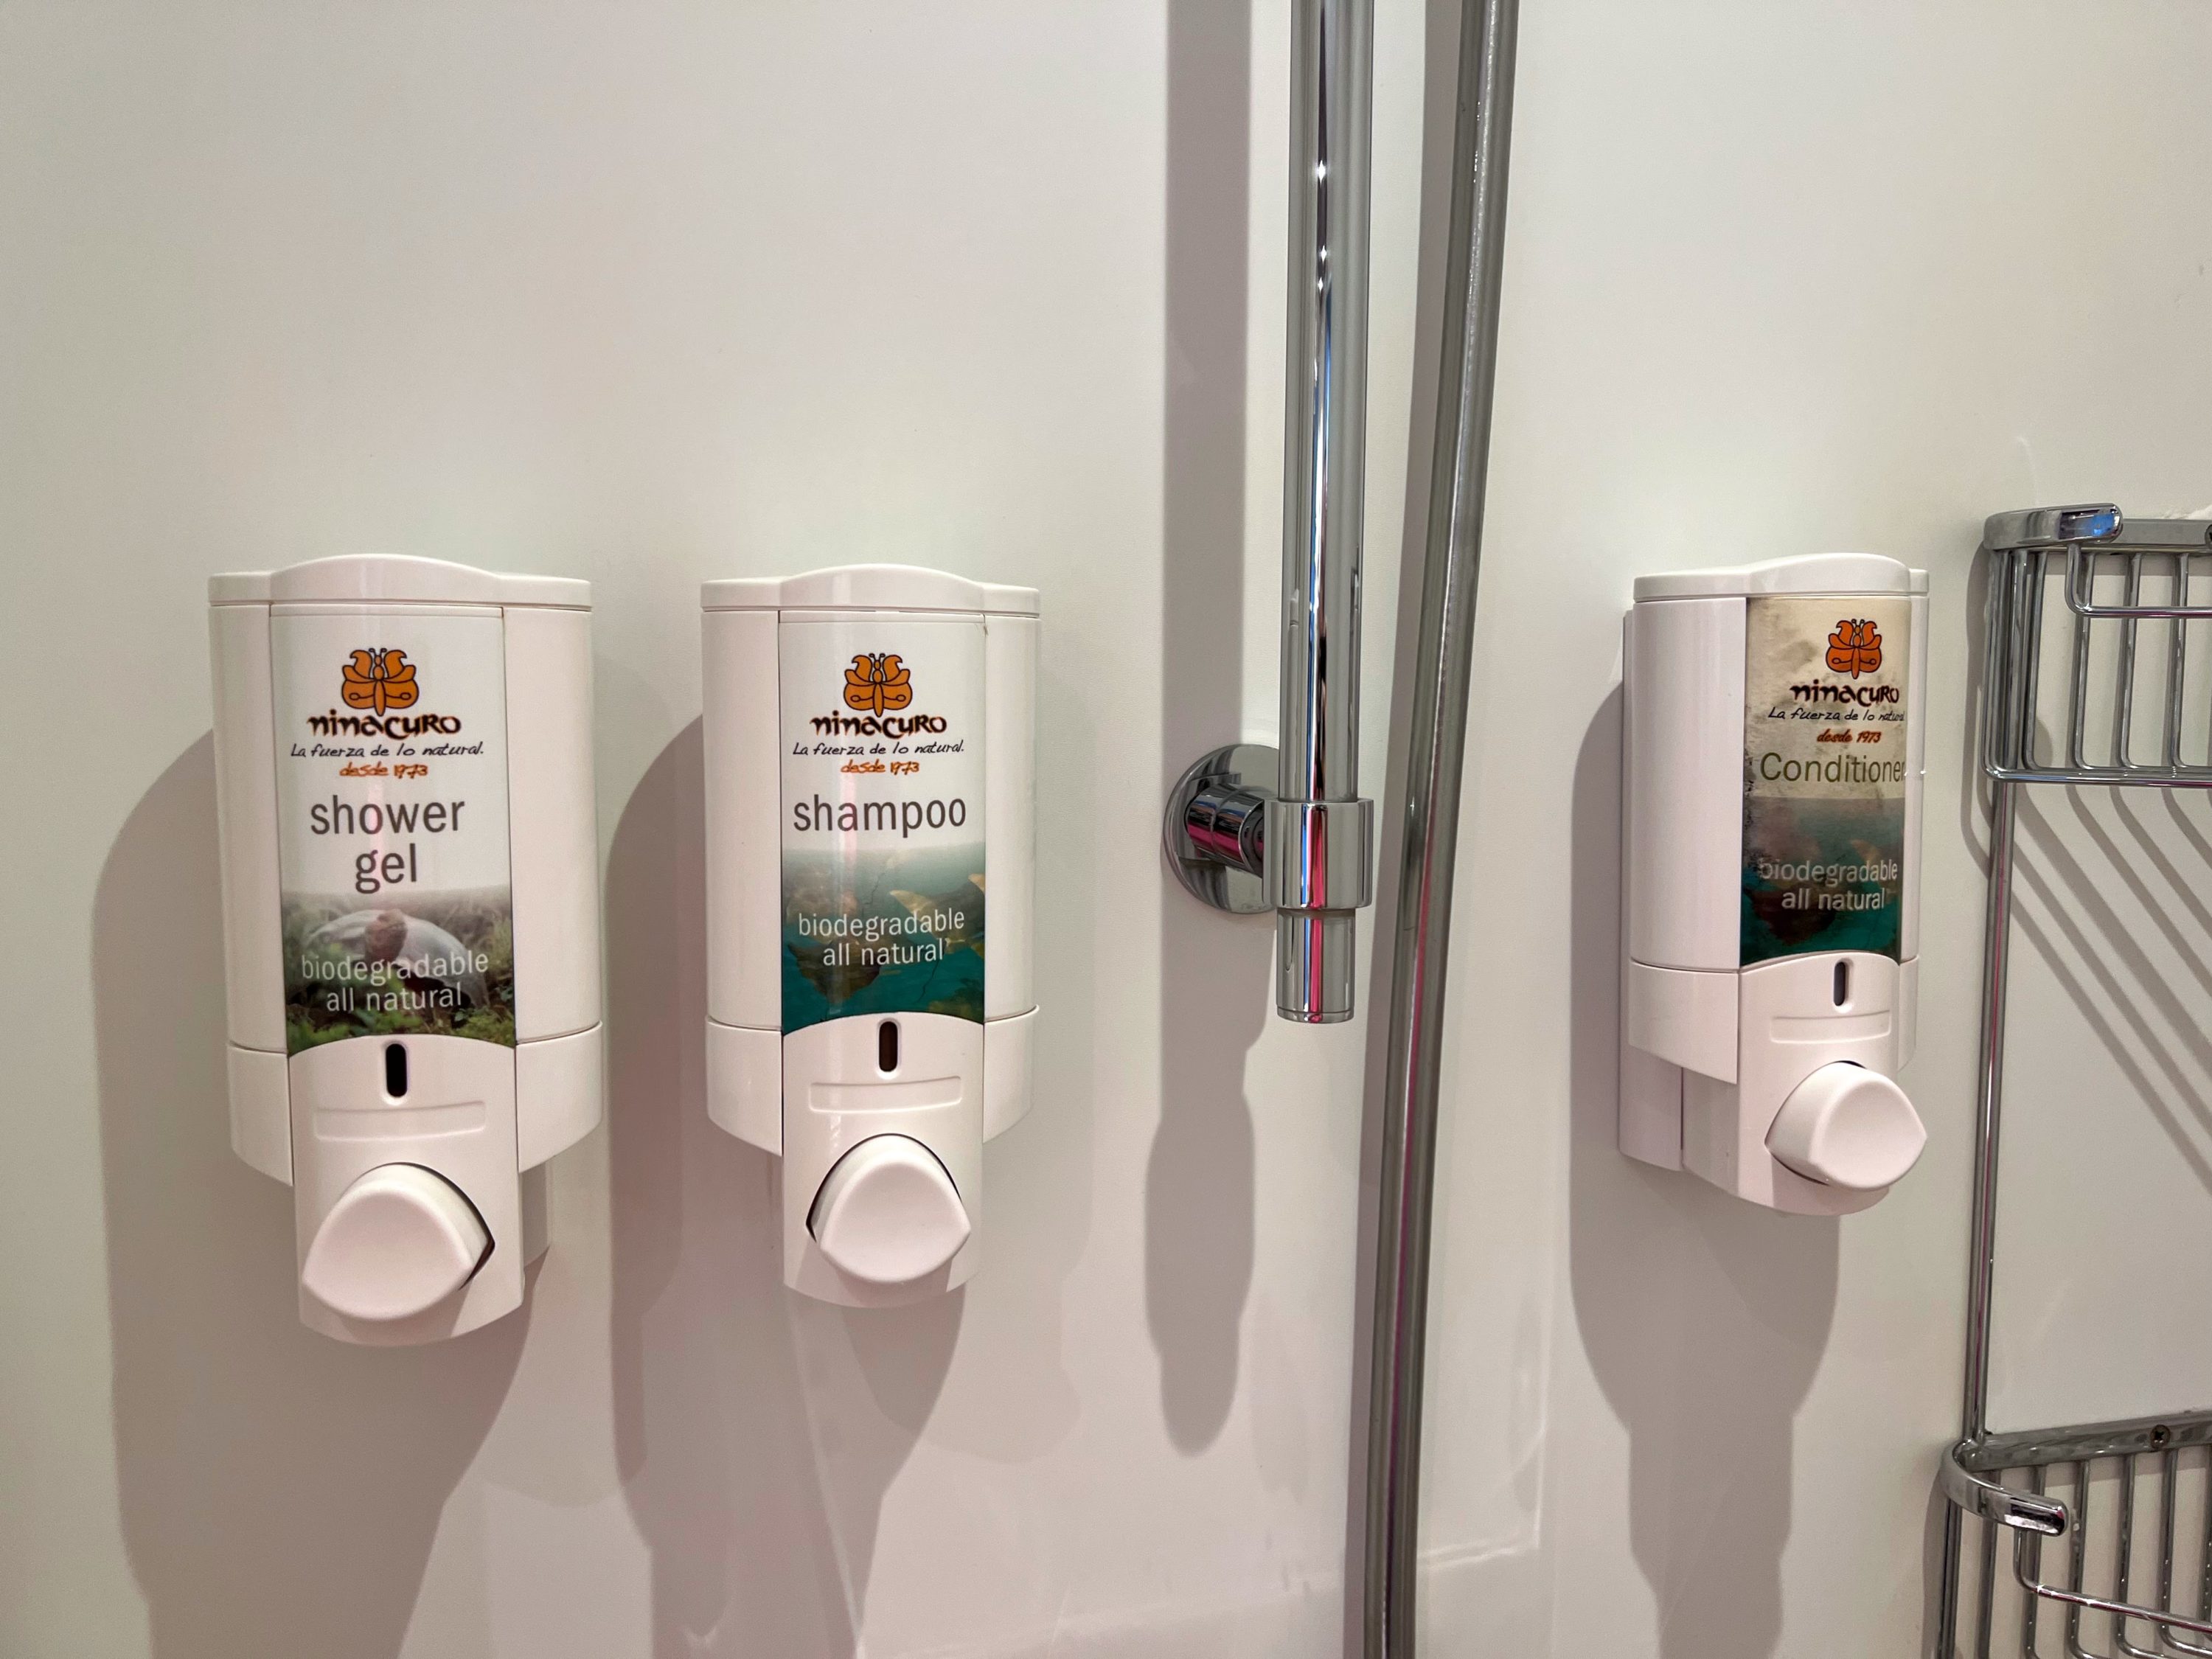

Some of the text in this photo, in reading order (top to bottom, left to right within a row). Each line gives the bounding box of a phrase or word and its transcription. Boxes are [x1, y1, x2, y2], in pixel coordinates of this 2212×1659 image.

[1768, 706, 1786, 720] La
[1791, 707, 1840, 721] fuerza
[1845, 709, 1858, 720] de
[1863, 709, 1875, 721] lo
[291, 741, 484, 758] La fuerza de lo natural.
[793, 740, 964, 756] La fuerza de lo natural.
[1817, 728, 1882, 743] desde 1973
[338, 761, 428, 779] desde 1973
[841, 759, 920, 776] desde 1973
[310, 794, 465, 835] shower
[793, 794, 967, 838] shampoo
[355, 843, 417, 894] gel
[1758, 858, 1899, 887] biodegradable
[1781, 887, 1885, 911] all natural
[798, 908, 965, 942] biodegradable
[823, 938, 944, 966] all natural
[302, 950, 489, 987] biodegradable
[327, 981, 462, 1012] all natural
